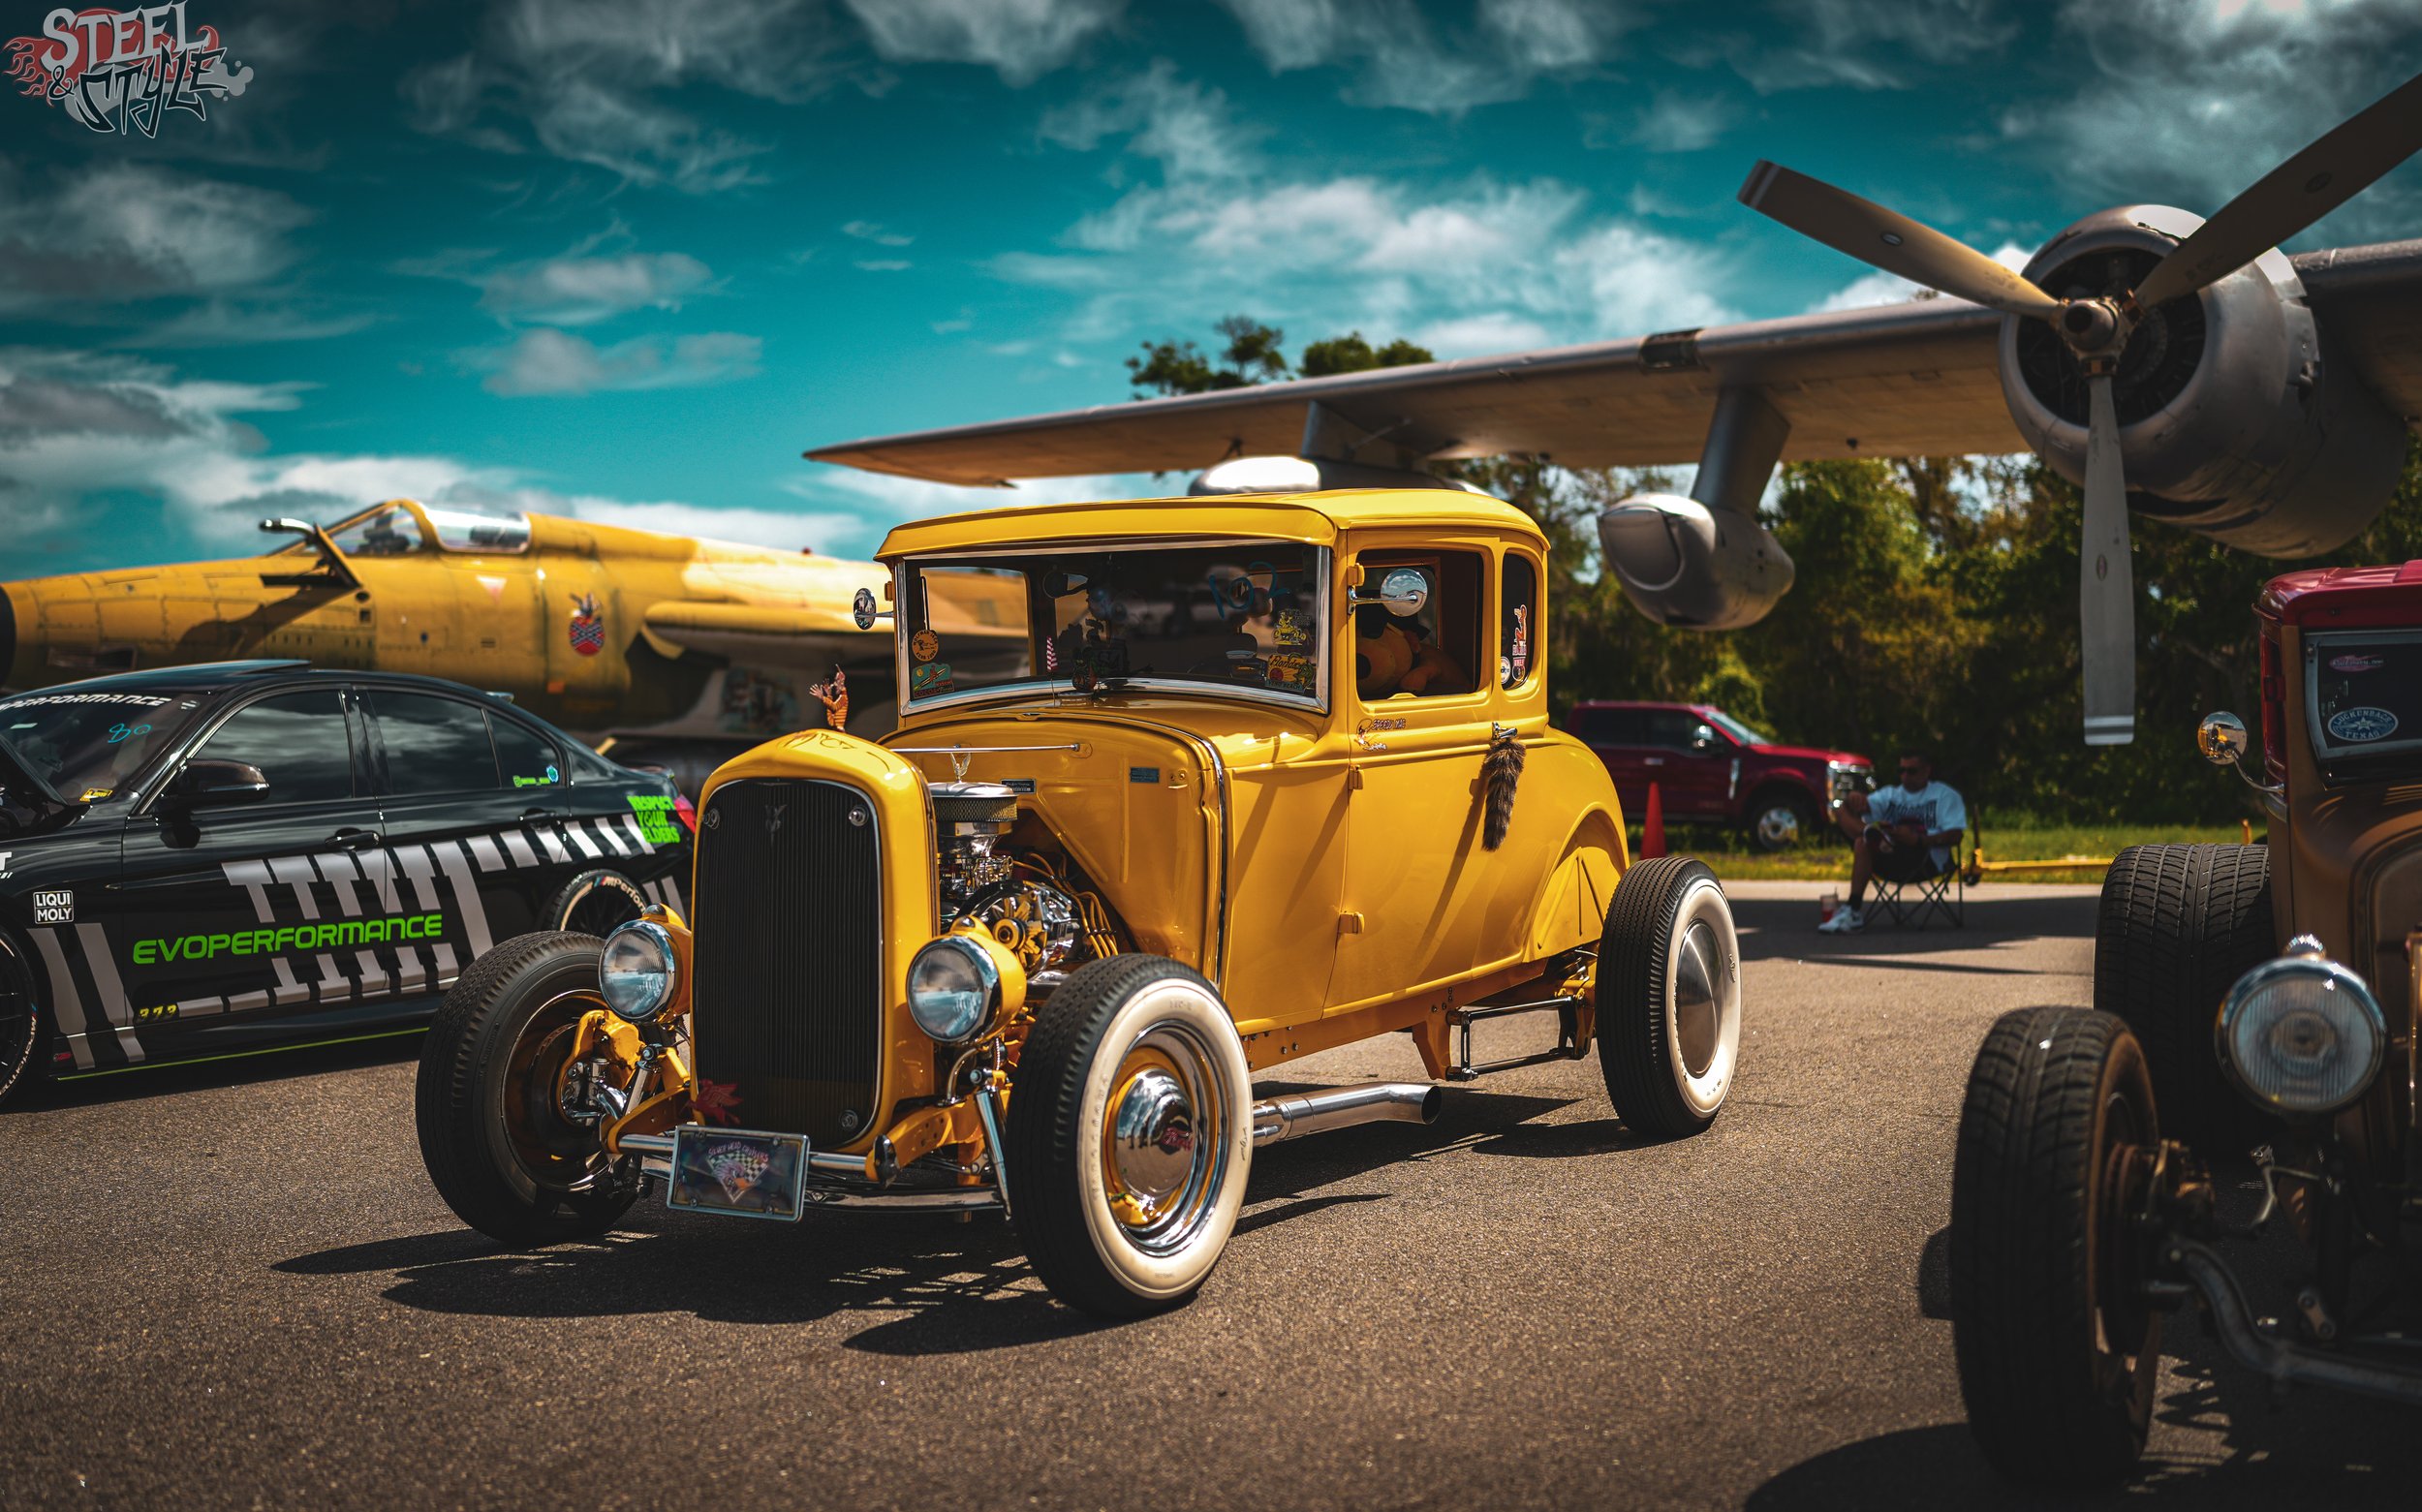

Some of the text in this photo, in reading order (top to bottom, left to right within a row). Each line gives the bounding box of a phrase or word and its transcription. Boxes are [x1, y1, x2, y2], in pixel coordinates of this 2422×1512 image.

[1208, 560, 1290, 620] 102
[108, 723, 152, 744] 80
[2345, 730, 2380, 740] TEXAS
[627, 795, 676, 811] RESPECT
[636, 811, 668, 828] YOUR
[641, 826, 680, 844] ELDERS
[35, 892, 71, 907] LIQUI
[37, 908, 72, 922] MOLY
[133, 914, 443, 964] EVOPERFORMANCE
